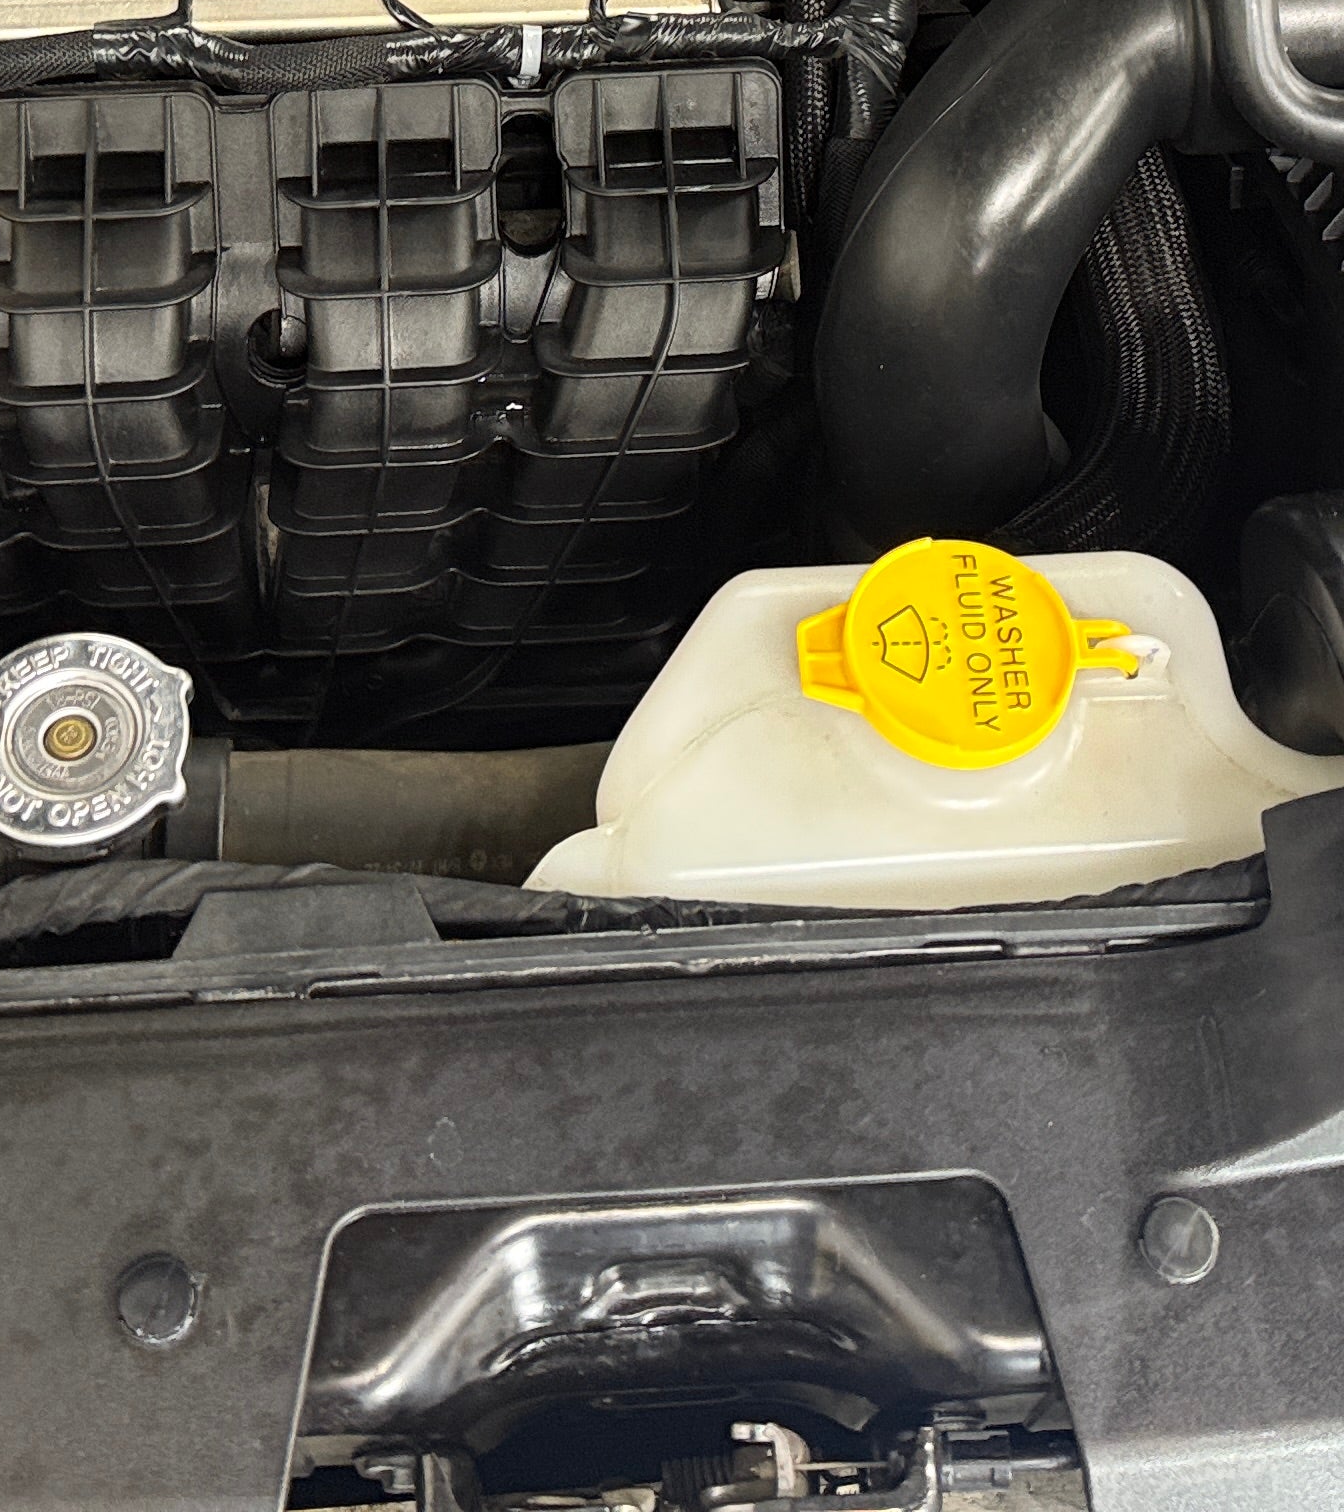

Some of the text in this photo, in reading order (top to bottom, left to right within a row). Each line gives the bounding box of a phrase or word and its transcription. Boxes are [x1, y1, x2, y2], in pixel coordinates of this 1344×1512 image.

[88, 645, 160, 691] TIGHT
[952, 554, 1001, 732] FLUID ONLY
[989, 575, 1032, 710] WASHER
[48, 794, 132, 827] OPEN
[127, 740, 171, 791] HOT
